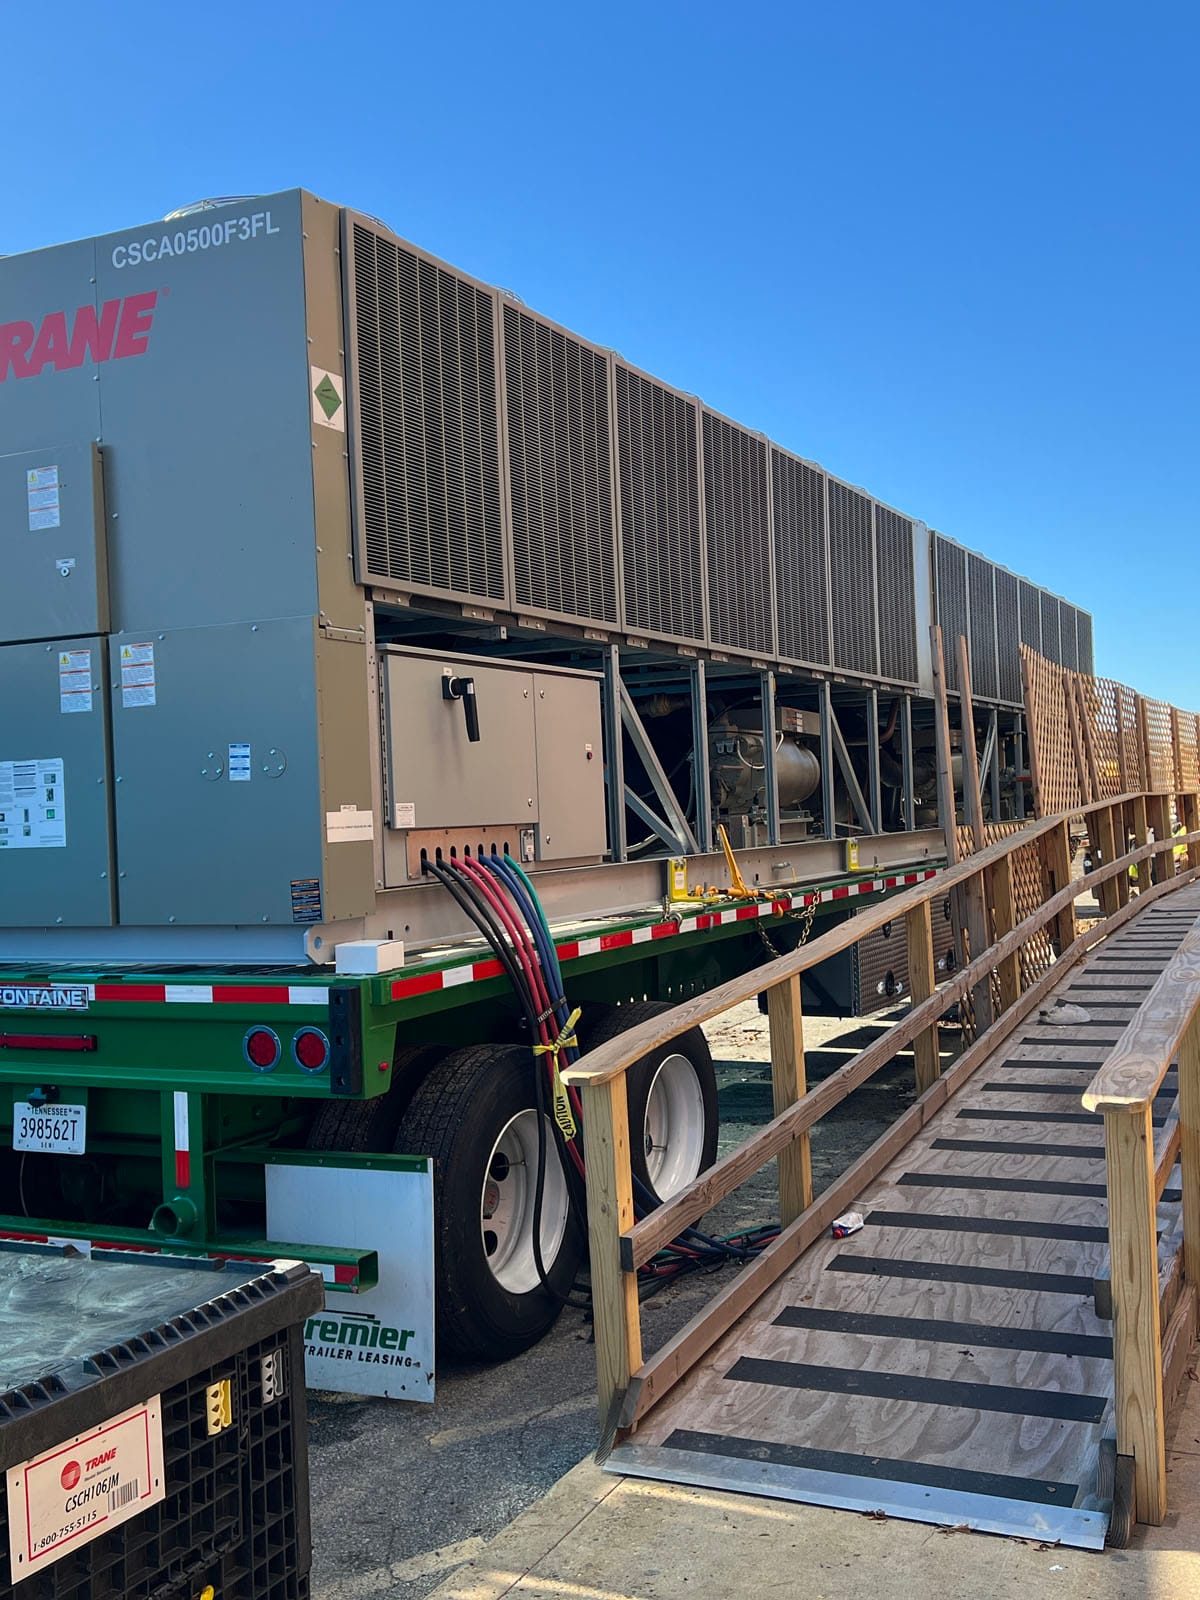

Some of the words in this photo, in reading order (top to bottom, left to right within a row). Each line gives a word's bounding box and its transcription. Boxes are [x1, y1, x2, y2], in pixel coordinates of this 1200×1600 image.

[112, 211, 280, 269] CSCA0500F3FL
[0, 989, 83, 1006] ONTAINE
[20, 1117, 78, 1141] 398562T
[556, 1096, 575, 1136] CAUTION
[304, 1318, 415, 1351] remier
[358, 1351, 412, 1368] LEASING
[85, 1447, 117, 1472] TRANE
[65, 1472, 120, 1513] CSCH106JM
[33, 1510, 97, 1552] 1-800-755-5115
